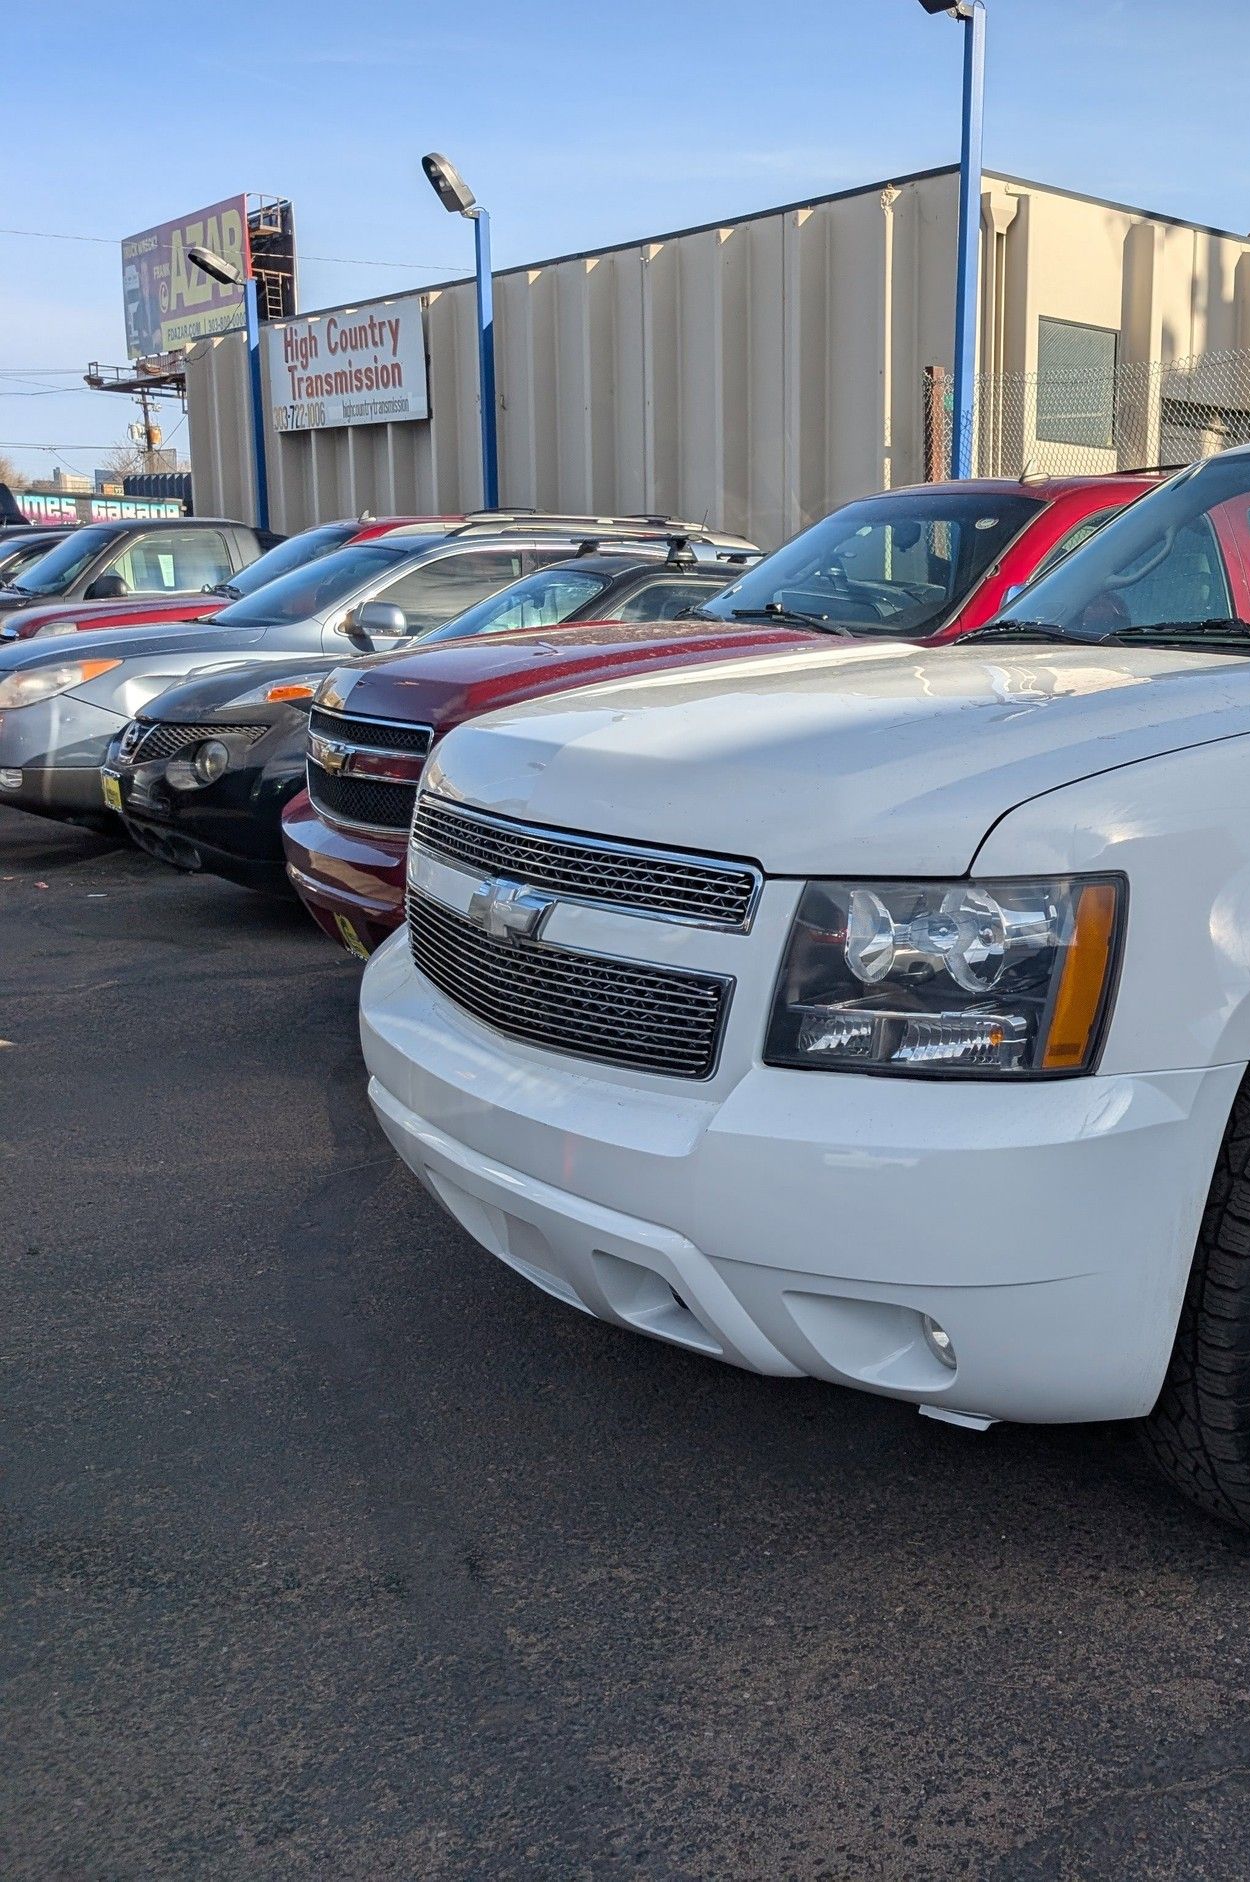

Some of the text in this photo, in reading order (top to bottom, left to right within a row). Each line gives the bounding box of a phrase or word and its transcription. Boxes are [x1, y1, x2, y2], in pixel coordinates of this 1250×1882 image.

[170, 209, 244, 311] AZAR
[283, 314, 400, 371] High Country
[287, 355, 403, 401] Transmission
